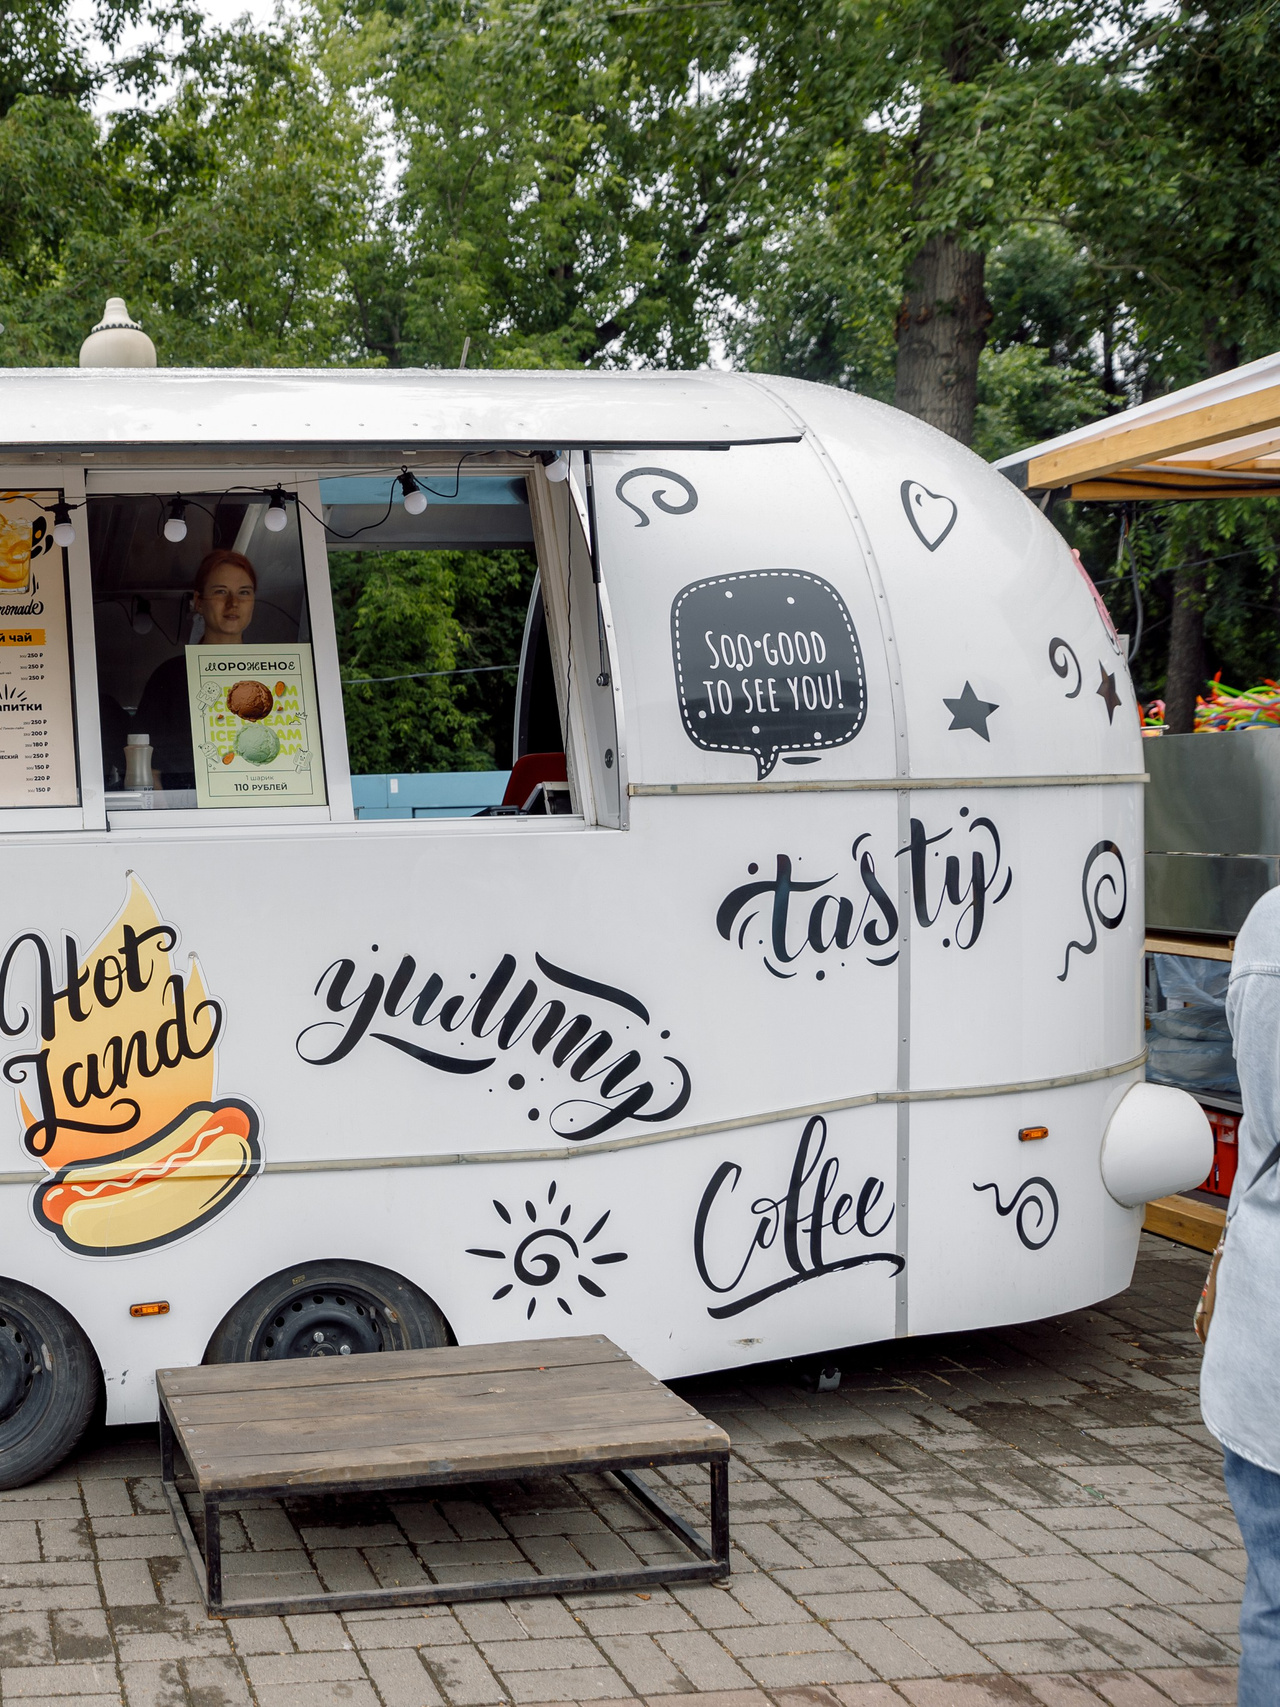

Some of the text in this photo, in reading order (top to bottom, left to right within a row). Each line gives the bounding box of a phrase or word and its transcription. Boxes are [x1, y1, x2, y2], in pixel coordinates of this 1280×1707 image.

[9, 633, 32, 642] чай
[705, 631, 827, 670] SOO GOOD
[205, 661, 296, 672] МОРОЖЕНОЕ
[702, 670, 844, 714] TO SEE YOU!
[209, 716, 236, 727] ICE
[211, 730, 236, 742] ICE
[252, 782, 287, 791] РУБЛЕЙ
[716, 816, 1001, 963] tasty
[3, 974, 223, 1157] Land
[694, 1114, 896, 1293] Coffee
